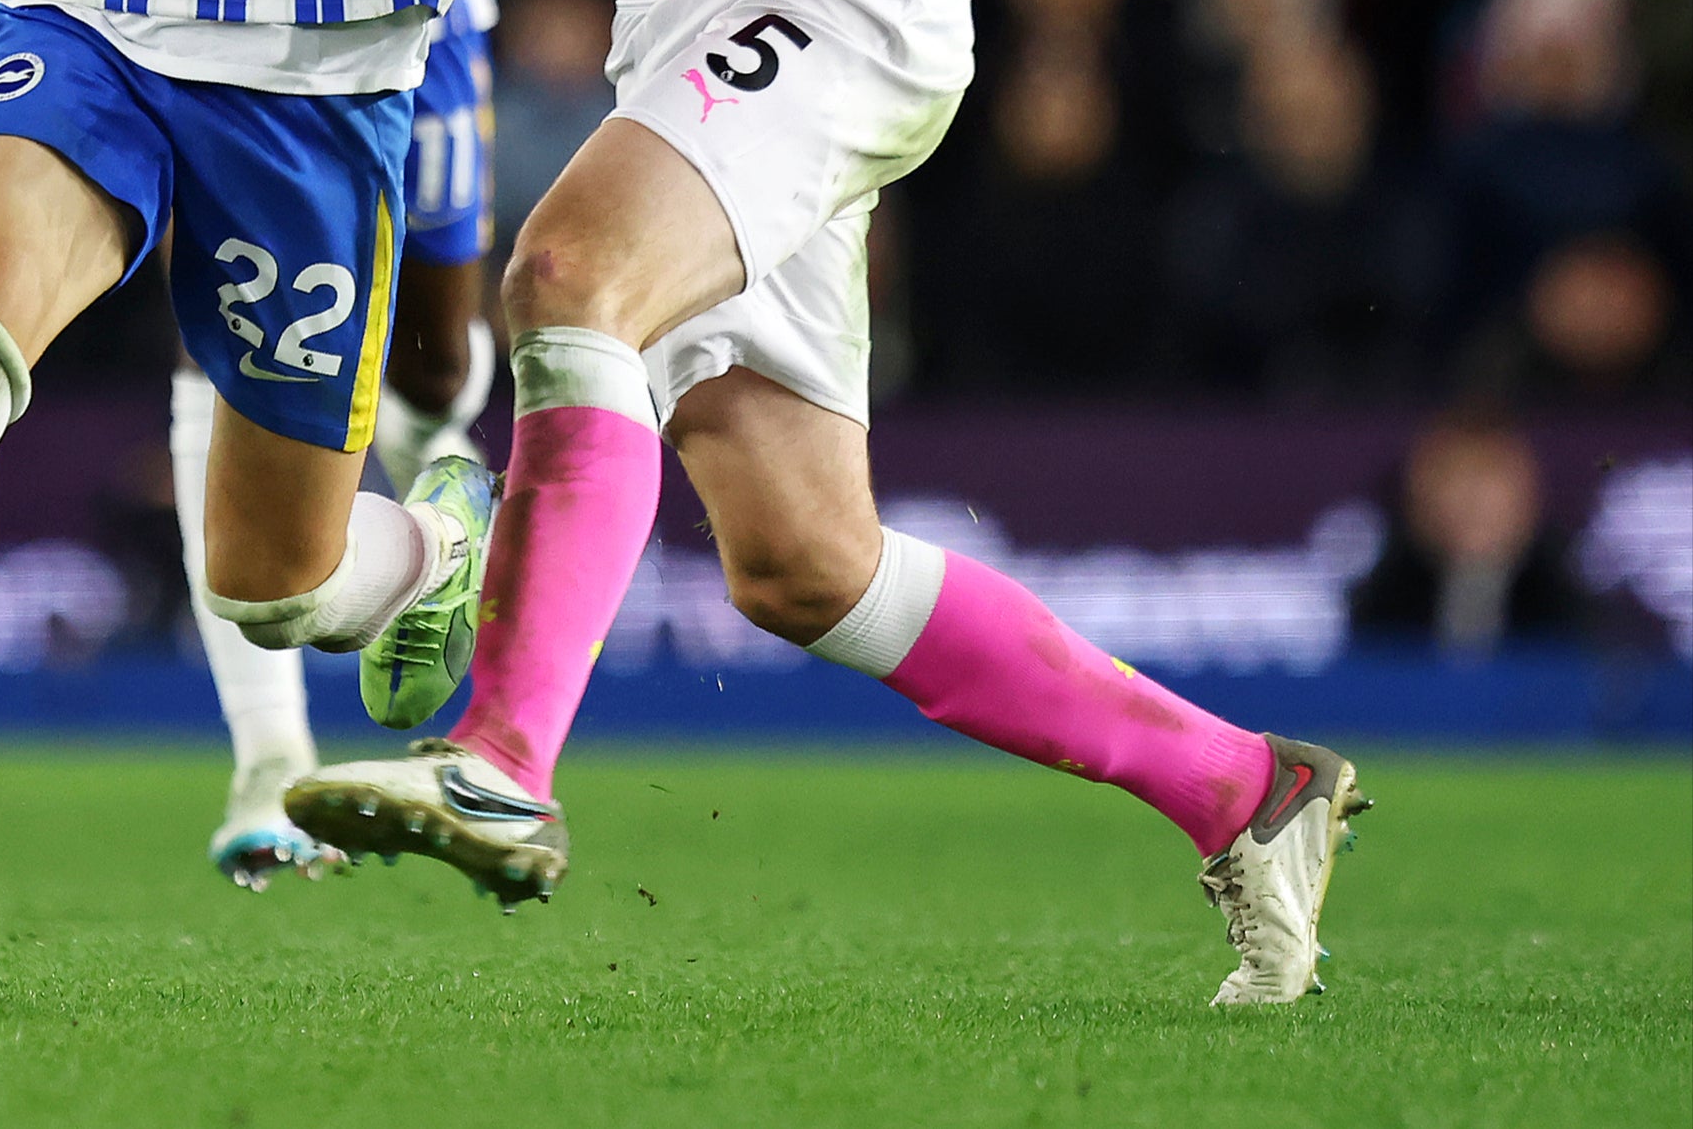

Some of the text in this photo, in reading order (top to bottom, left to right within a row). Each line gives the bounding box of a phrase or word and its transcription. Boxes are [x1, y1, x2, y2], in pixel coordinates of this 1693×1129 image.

[706, 13, 813, 92] 5
[412, 108, 476, 212] 11
[214, 237, 356, 377] 22
